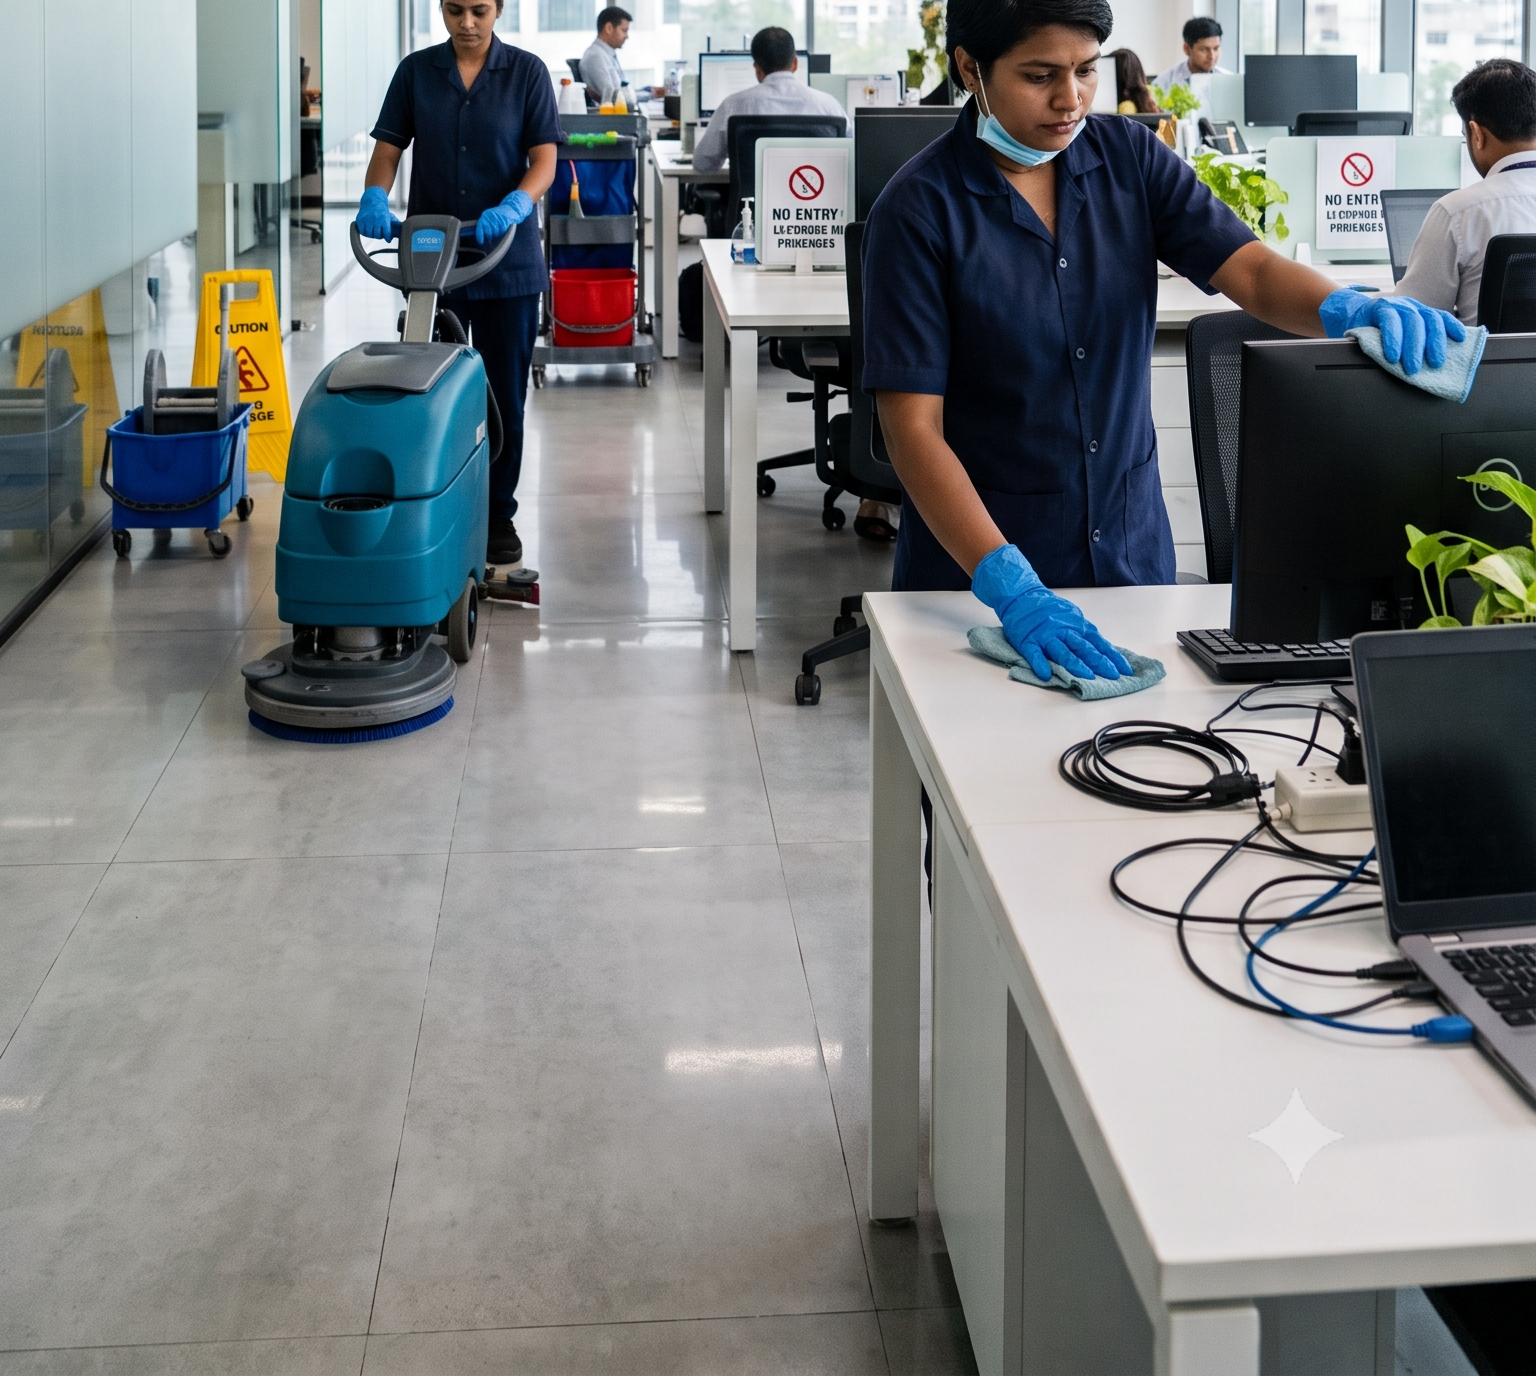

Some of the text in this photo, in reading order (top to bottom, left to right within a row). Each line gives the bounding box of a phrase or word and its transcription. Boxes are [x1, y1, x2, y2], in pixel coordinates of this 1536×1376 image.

[1325, 194, 1379, 206] NO ENTR
[772, 208, 839, 221] NO ENTRY
[214, 322, 269, 335] CUTION
[249, 411, 275, 422] SGE
